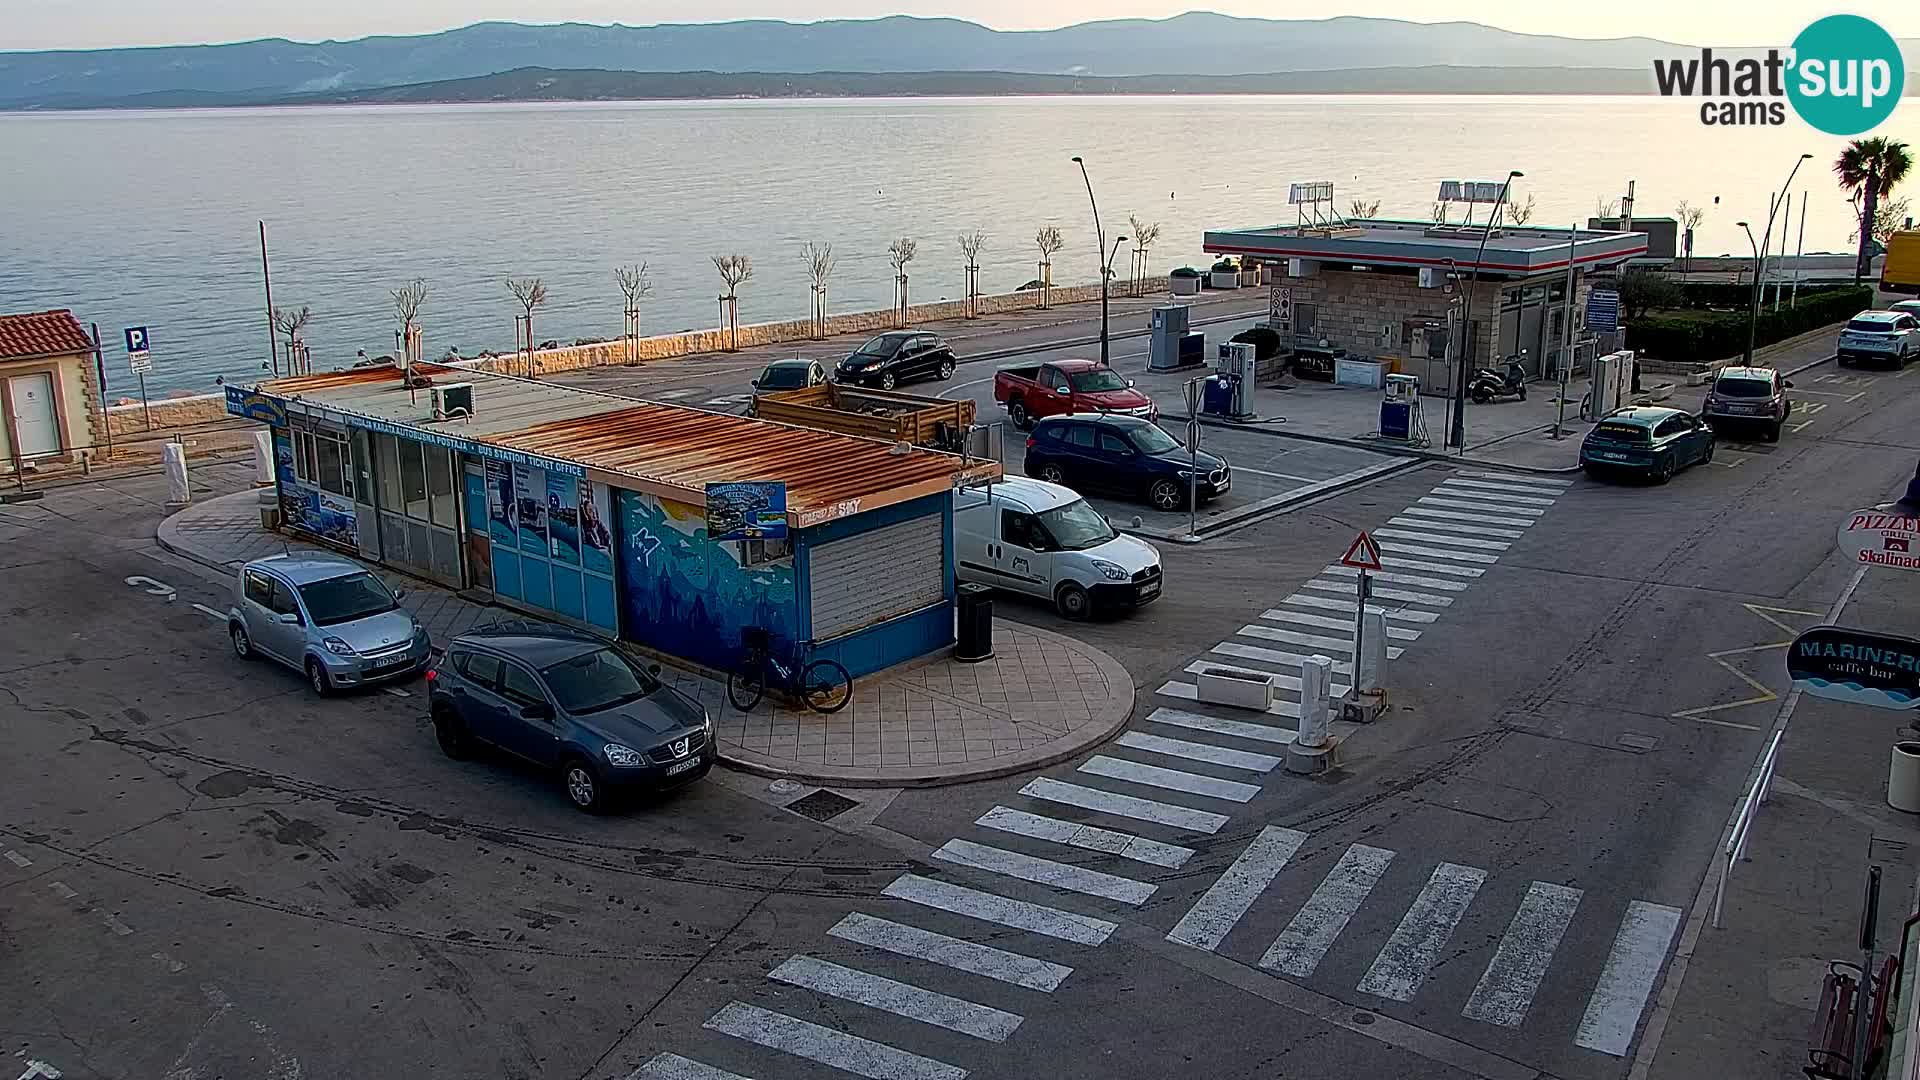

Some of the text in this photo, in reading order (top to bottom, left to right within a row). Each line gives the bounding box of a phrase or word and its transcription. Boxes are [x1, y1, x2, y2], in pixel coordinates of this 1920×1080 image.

[130, 330, 143, 349] P
[437, 437, 468, 451] POSTAJA
[494, 448, 527, 464] STATION
[527, 456, 554, 471] TICKET
[555, 462, 583, 477] OFFICE
[1847, 514, 1920, 534] PIZZE
[1880, 530, 1917, 541] GRILL
[1828, 662, 1896, 680] caffe bar
